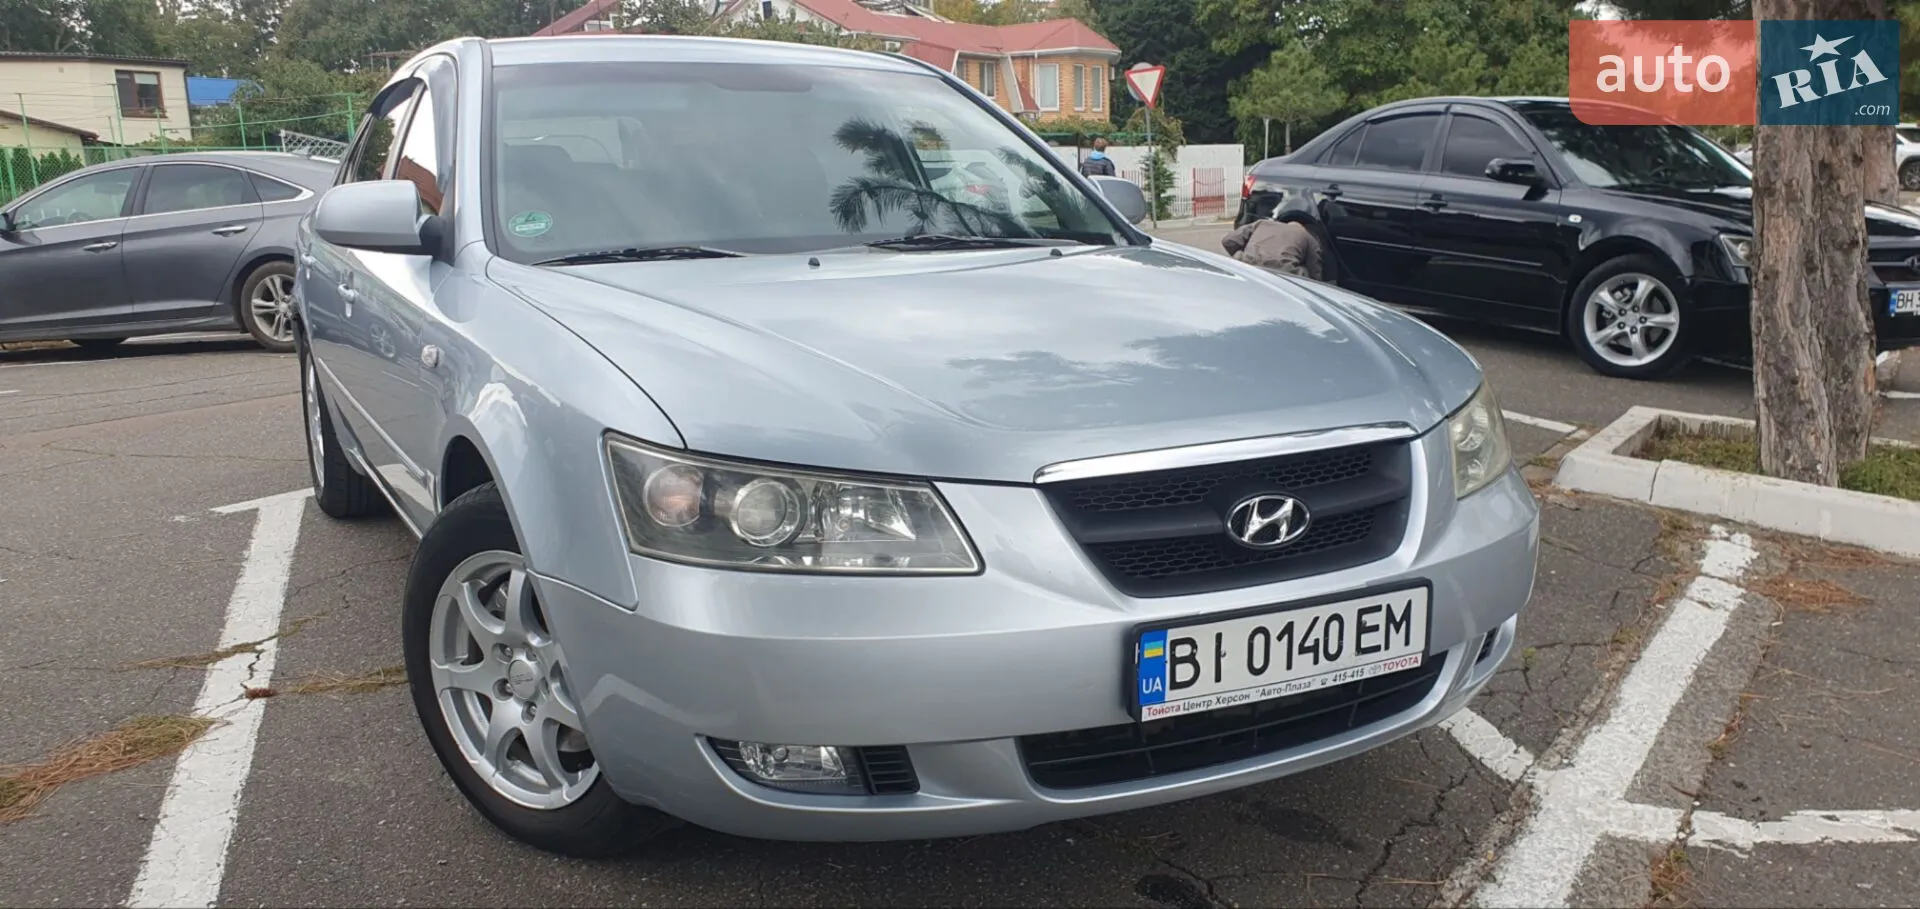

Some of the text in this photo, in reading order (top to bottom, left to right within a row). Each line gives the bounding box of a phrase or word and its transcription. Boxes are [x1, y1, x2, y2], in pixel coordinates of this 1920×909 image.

[1169, 599, 1412, 691] BI 0140 EM
[1142, 676, 1163, 694] UA
[1183, 699, 1212, 712] Центр
[1215, 694, 1250, 706] Херсон
[1332, 667, 1364, 683] 415-415
[1382, 656, 1419, 672] TOYOTA
